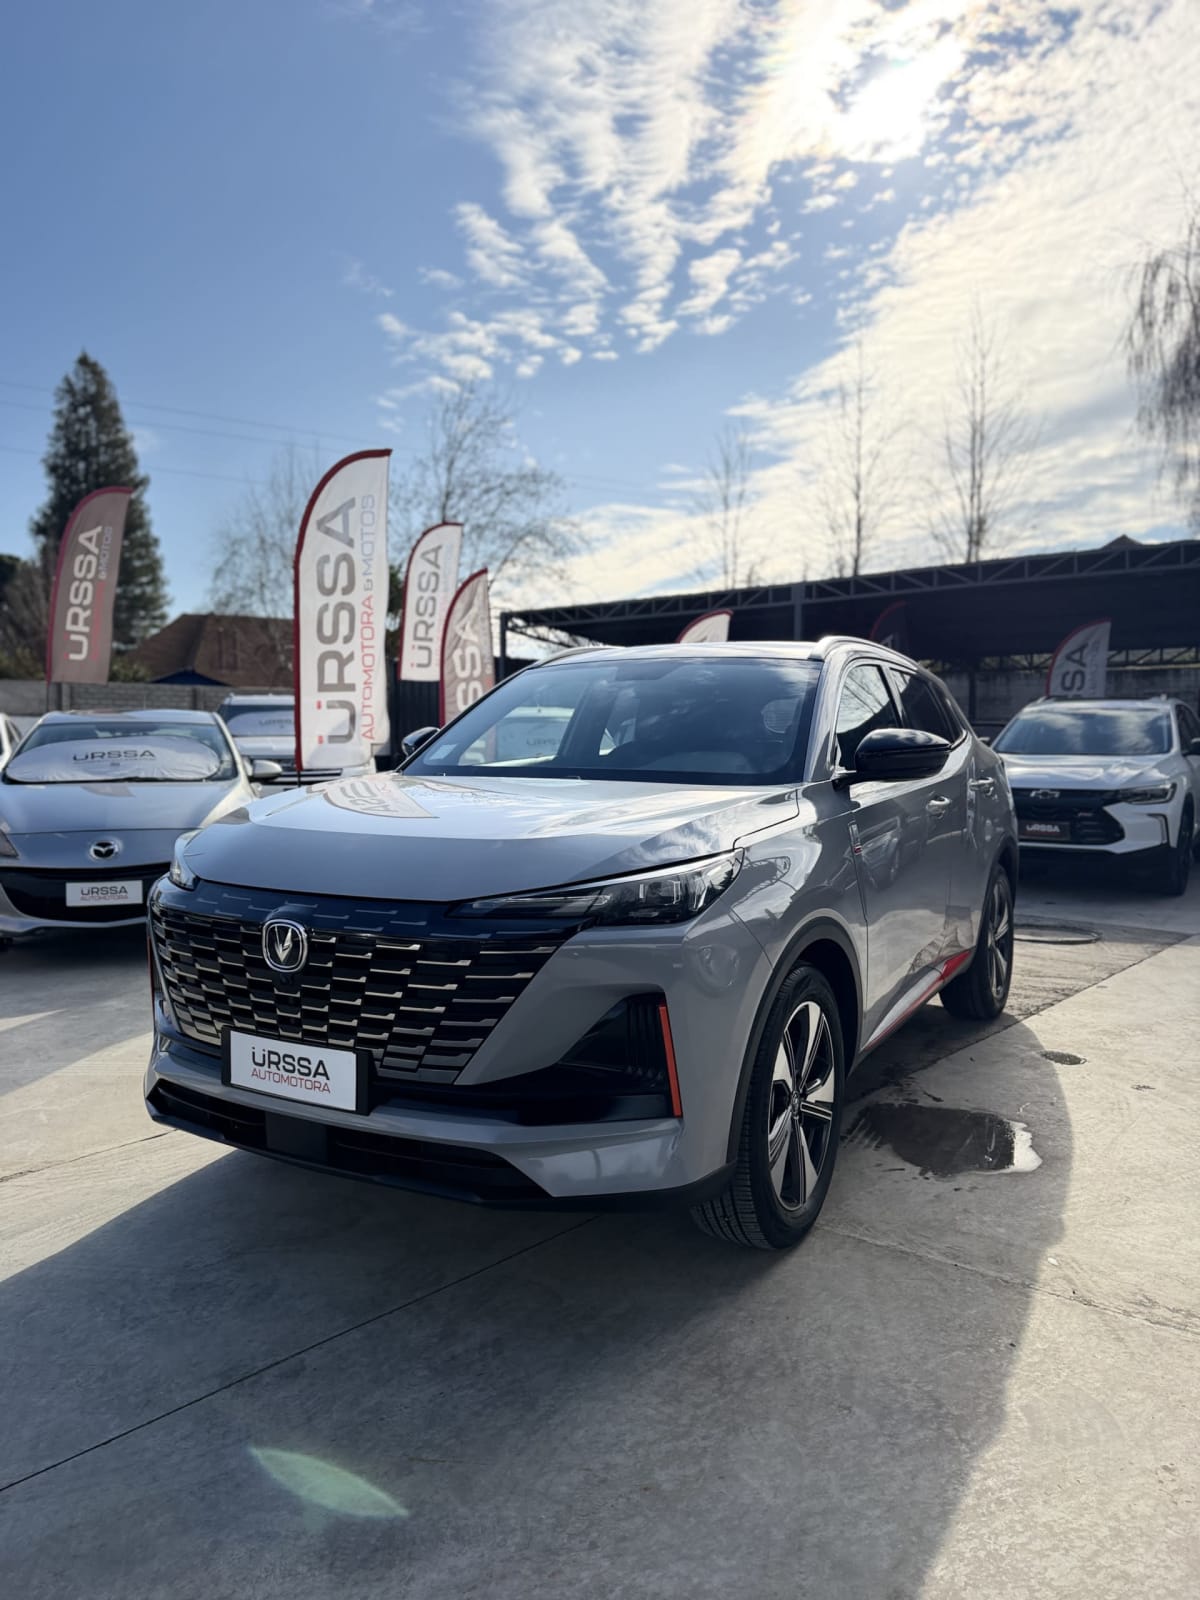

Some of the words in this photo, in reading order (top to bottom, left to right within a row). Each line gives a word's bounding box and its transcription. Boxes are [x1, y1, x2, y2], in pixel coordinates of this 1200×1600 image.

[360, 493, 376, 577] MOTOS
[363, 578, 374, 591] &
[360, 594, 376, 740] AUTOMOTORA
[453, 605, 486, 712] SSA
[251, 1068, 331, 1094] AUTOMOTORA
